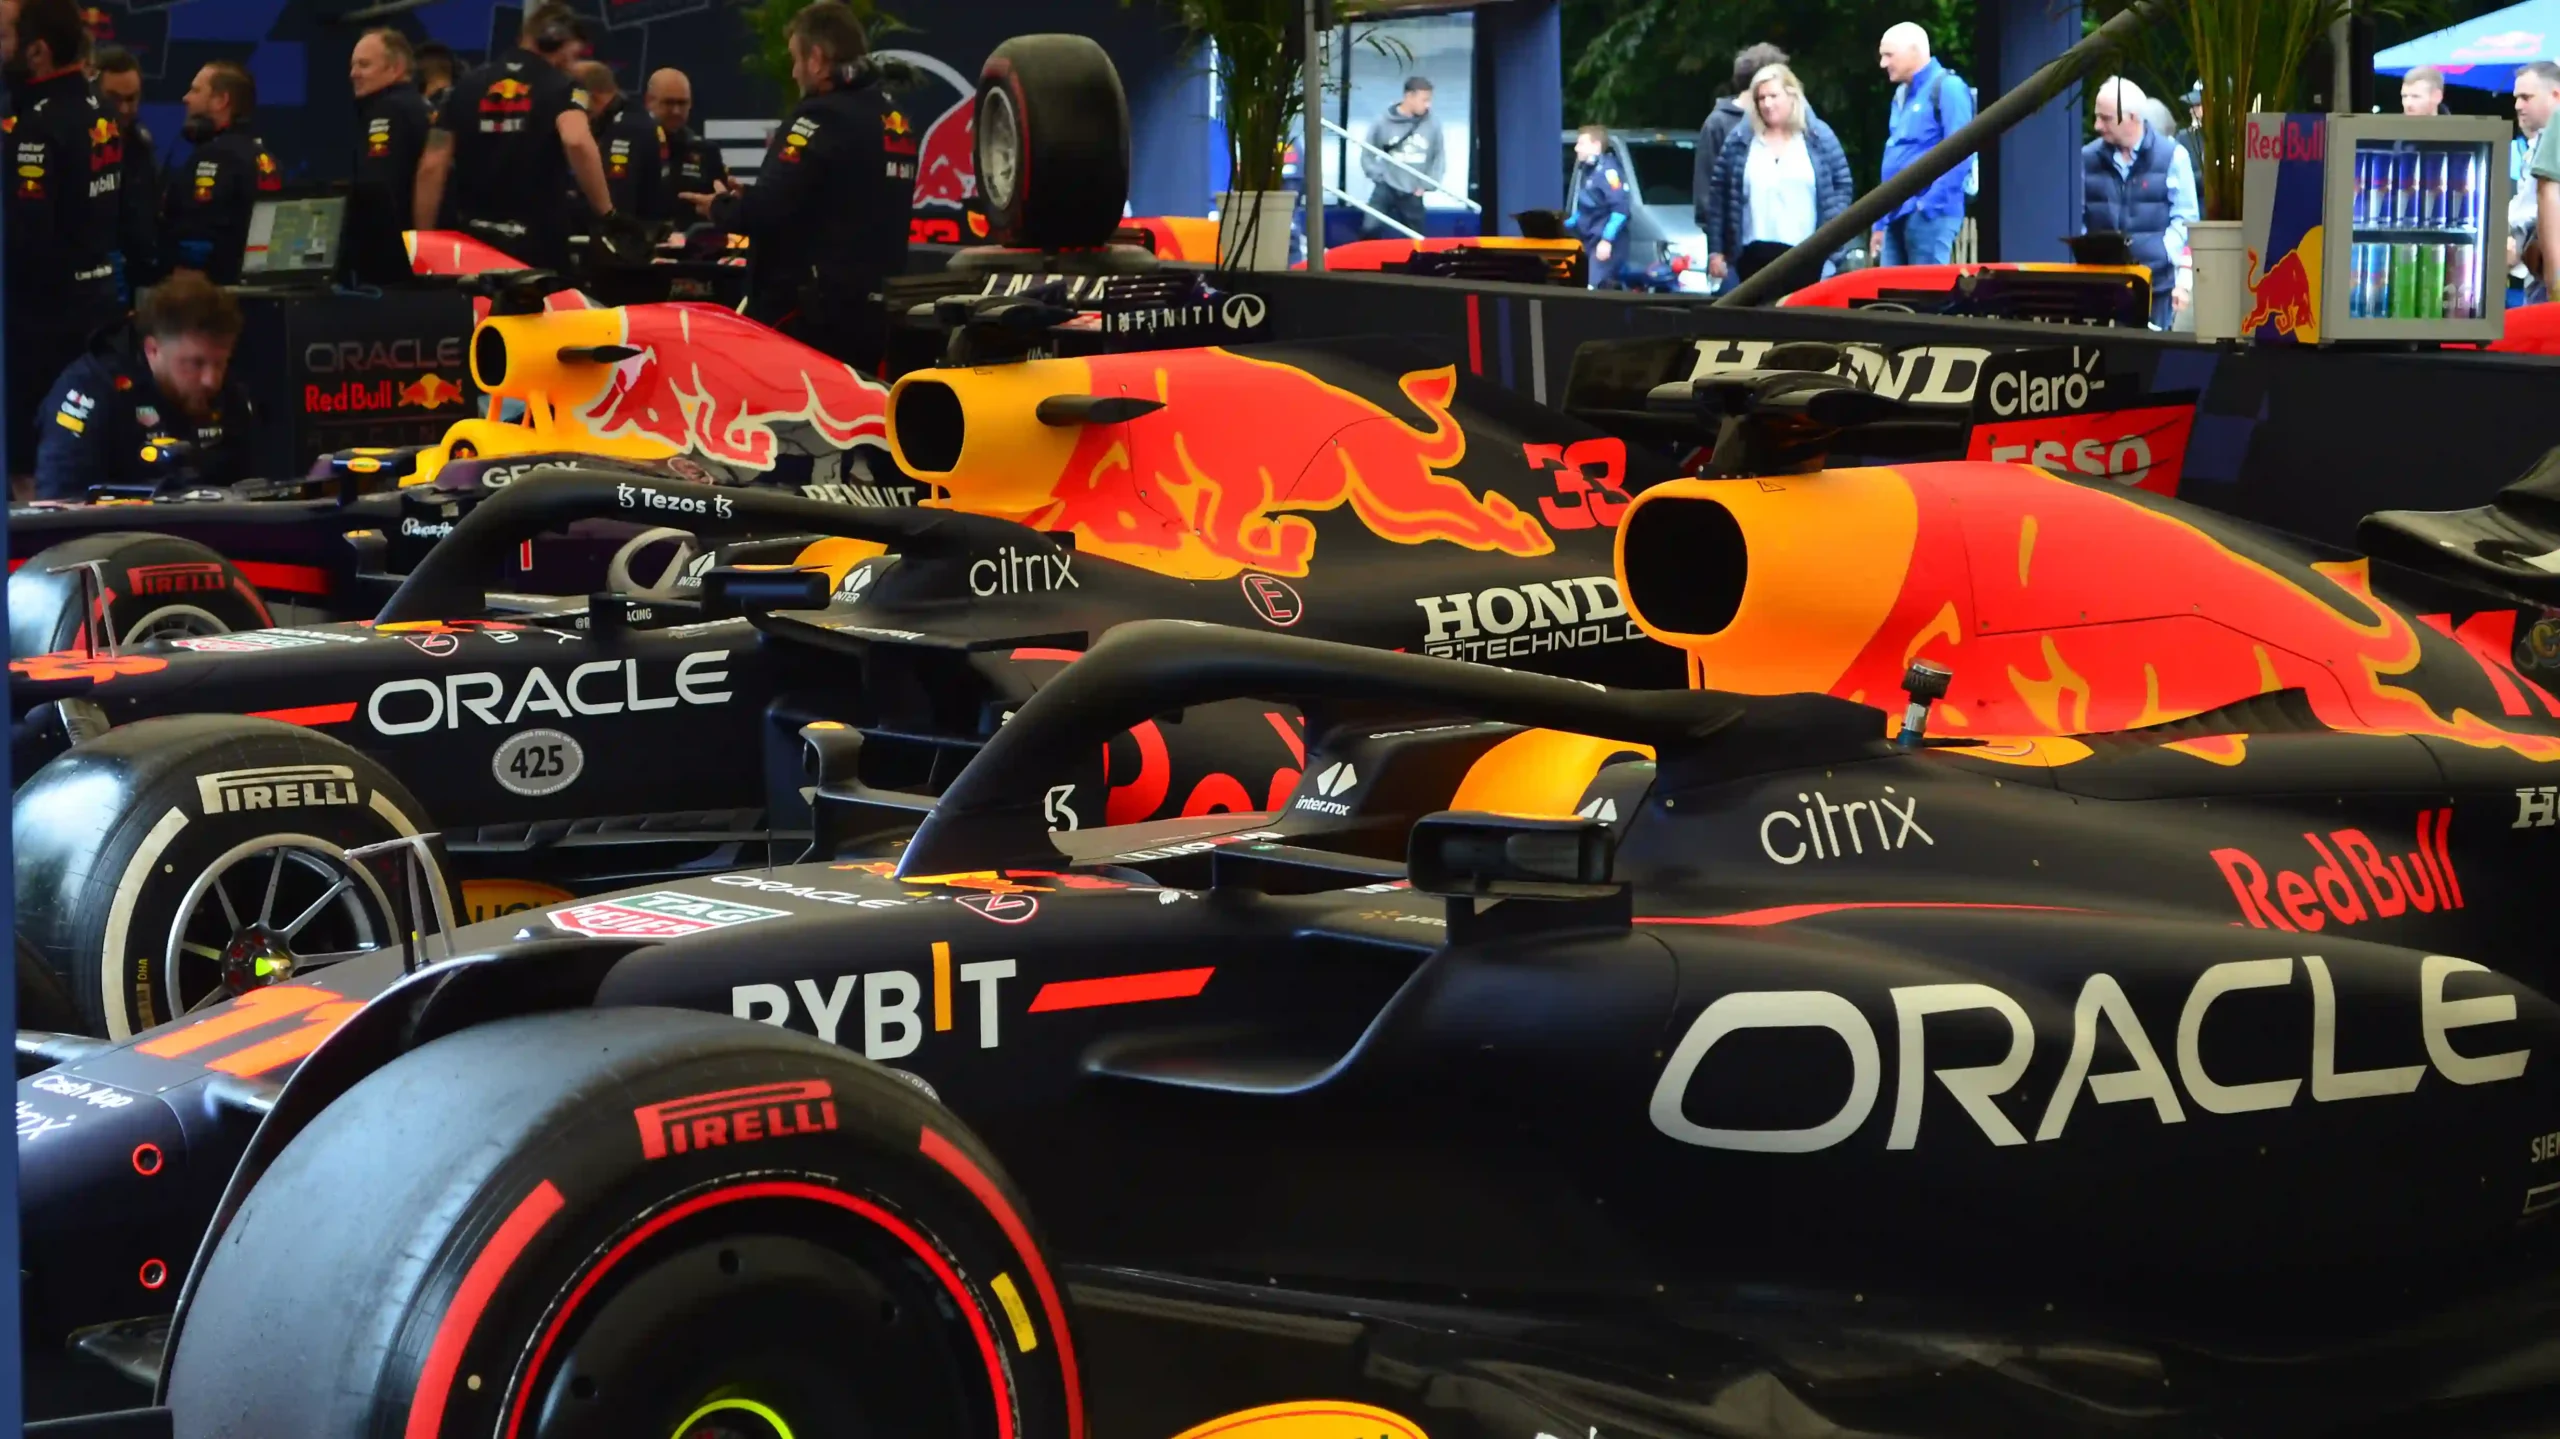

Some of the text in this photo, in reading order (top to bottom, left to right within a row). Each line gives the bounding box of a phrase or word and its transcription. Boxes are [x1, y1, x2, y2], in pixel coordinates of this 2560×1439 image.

[2247, 120, 2324, 161] Red Bull
[1106, 305, 1214, 333] INFINITI
[305, 337, 462, 373] ORACLE
[304, 379, 393, 413] Red Bull
[1989, 370, 2090, 416] Claro
[641, 487, 707, 514] Tezos
[127, 562, 226, 596] PIRELLI
[968, 545, 1080, 597] citrix
[1415, 576, 1628, 642] HOND
[367, 649, 733, 736] ORACLE
[509, 744, 565, 779] 425
[196, 764, 359, 815] PIRELLI
[1295, 795, 1352, 817] inter.mx
[1760, 786, 1935, 865] citrix
[2209, 807, 2464, 933] Red Bull
[642, 895, 754, 922] TAG
[711, 875, 906, 909] ORACLE
[570, 905, 703, 935] HEUER
[1649, 955, 2532, 1153] ORACLE
[634, 1080, 839, 1161] PIRELLI
